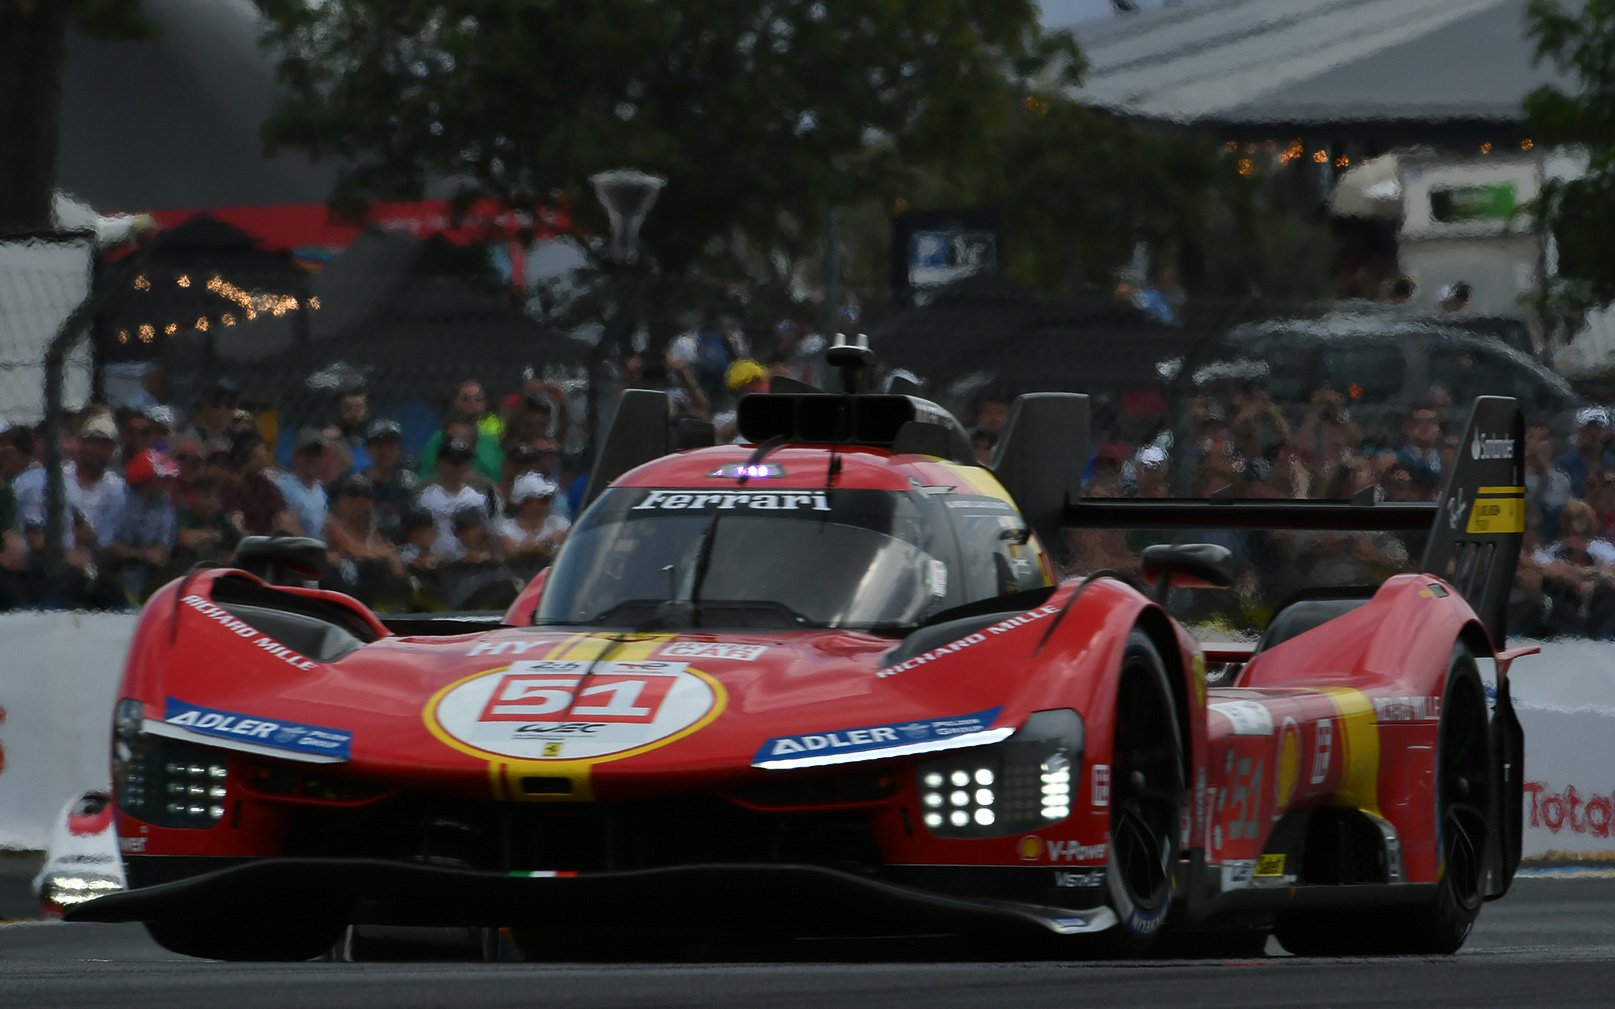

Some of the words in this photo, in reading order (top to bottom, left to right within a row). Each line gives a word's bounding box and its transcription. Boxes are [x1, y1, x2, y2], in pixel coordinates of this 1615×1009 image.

[632, 490, 831, 512] Ferrari
[181, 594, 258, 639] RICHARD
[252, 636, 319, 671] MILLE
[876, 632, 987, 678] RICHARD
[986, 604, 1061, 635] MILLE
[491, 679, 652, 716] 51
[166, 710, 283, 739] ADLER
[515, 722, 607, 734] WEC
[771, 726, 899, 755] ADLER
[1229, 757, 1264, 839] 51
